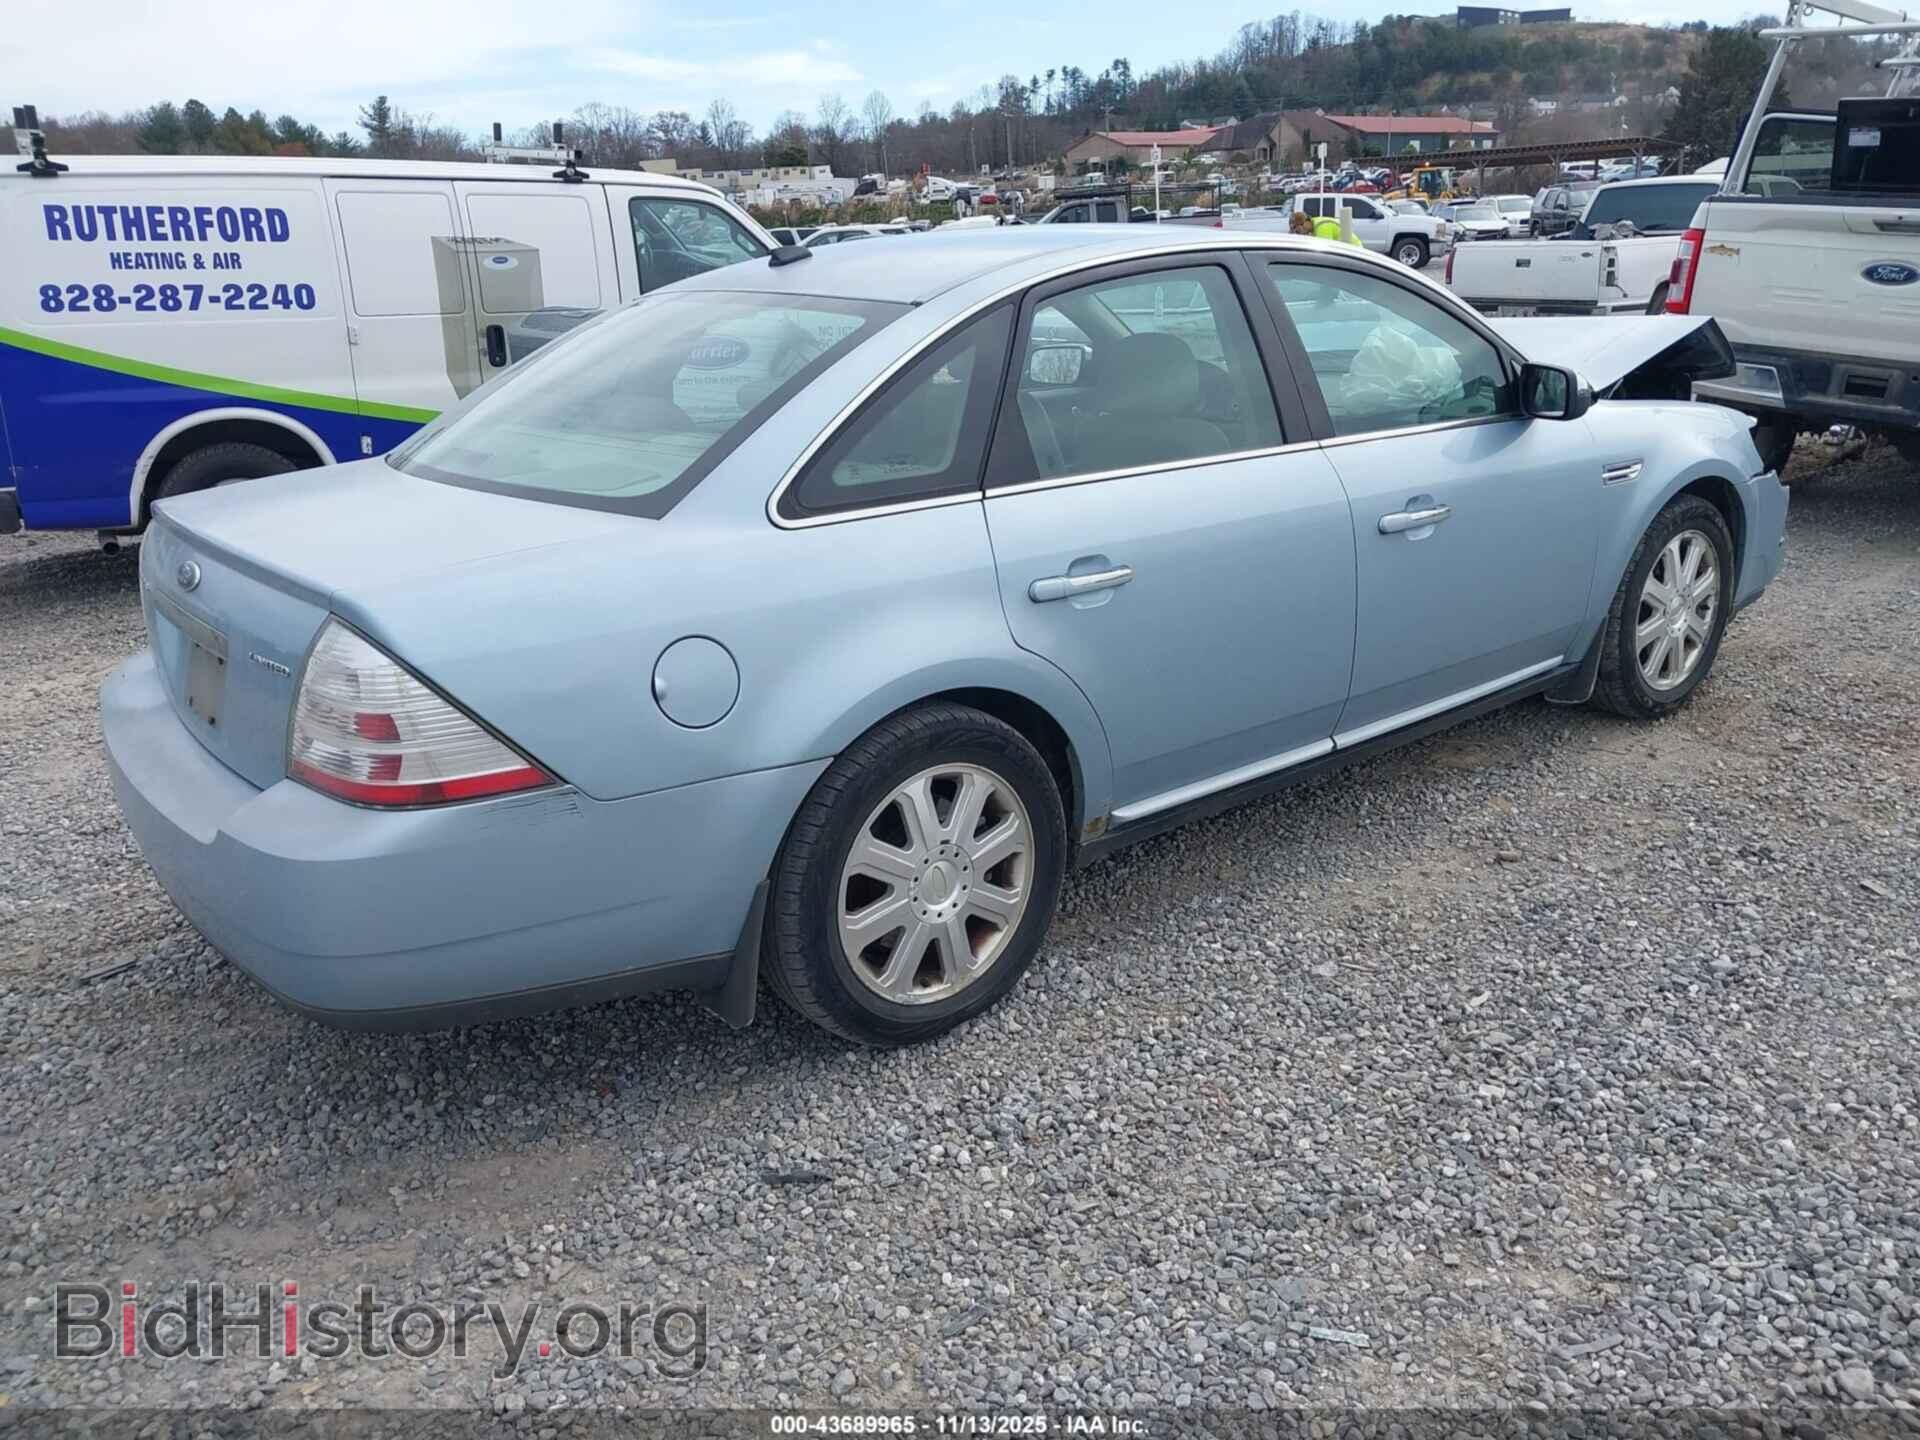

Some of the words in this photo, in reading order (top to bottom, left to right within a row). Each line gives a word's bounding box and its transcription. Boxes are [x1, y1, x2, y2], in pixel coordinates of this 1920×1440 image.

[43, 205, 290, 243] RUTHERFORD
[110, 252, 187, 270] HEATING
[194, 252, 206, 270] &
[213, 252, 242, 270] AIR
[39, 283, 317, 312] 828-287-2240
